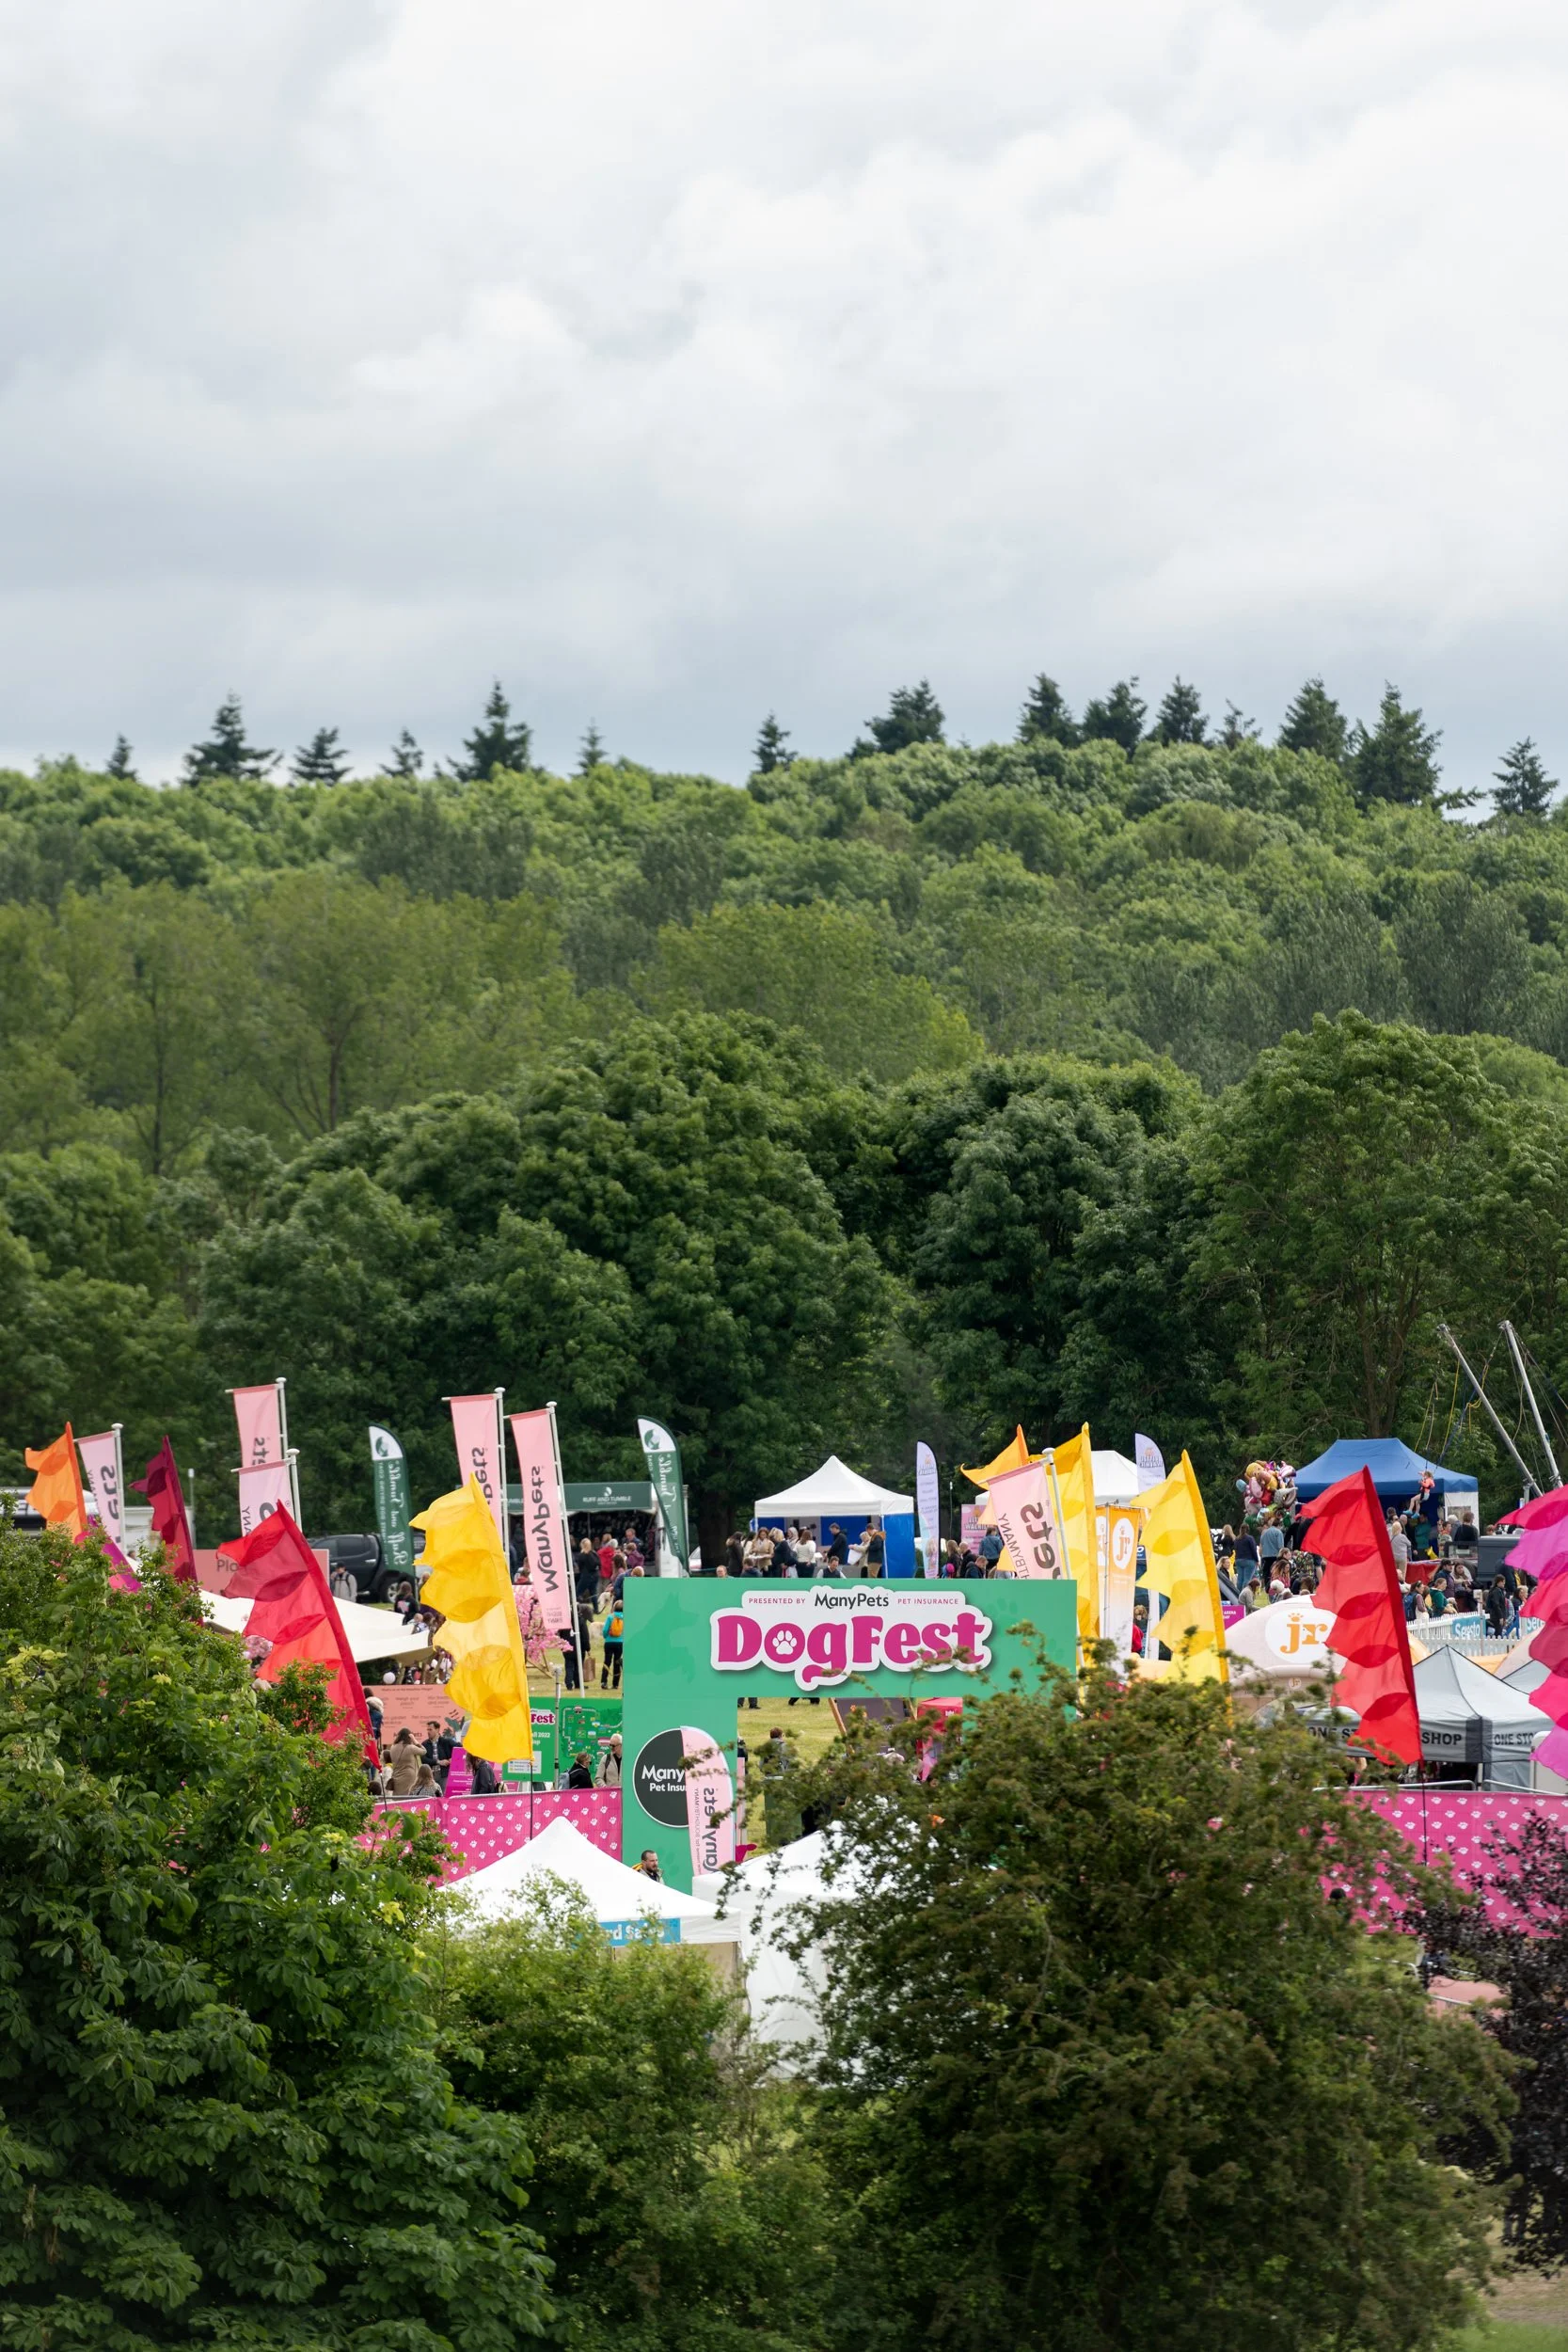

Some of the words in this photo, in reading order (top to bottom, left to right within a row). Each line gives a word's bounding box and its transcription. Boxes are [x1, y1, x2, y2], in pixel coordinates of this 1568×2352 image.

[815, 1593, 890, 1610] ManyPets
[1279, 1613, 1328, 1654] jr
[717, 1612, 985, 1683] DogFest
[1421, 1732, 1462, 1745] SHOP
[1494, 1733, 1515, 1746] ONE
[1516, 1732, 1534, 1746] STO
[649, 1783, 665, 1792] Pet
[667, 1783, 687, 1792] Insu
